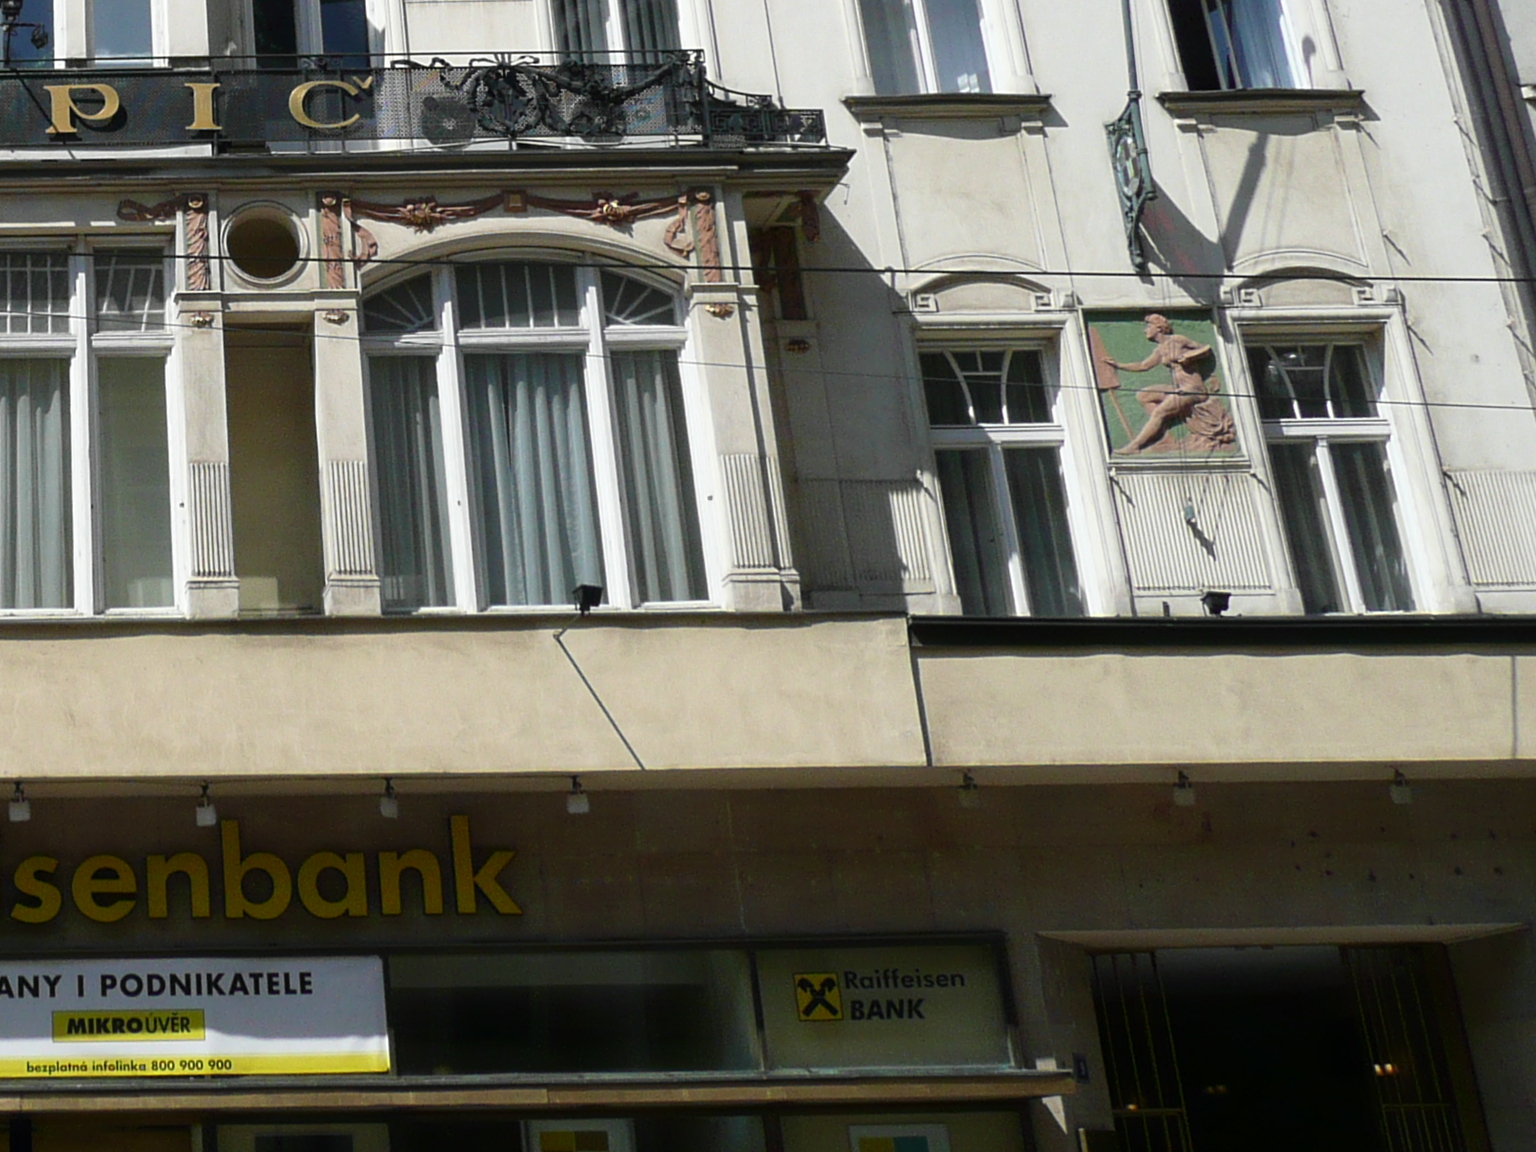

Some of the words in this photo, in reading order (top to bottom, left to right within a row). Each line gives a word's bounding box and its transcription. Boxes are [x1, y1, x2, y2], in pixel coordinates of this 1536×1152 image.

[76, 974, 86, 998] I
[99, 971, 314, 997] PODNIKATELE
[844, 968, 966, 990] Raiffeisen
[850, 999, 926, 1021] BANK
[66, 1011, 192, 1036] MIKROÚVĚR
[25, 1060, 89, 1075] bezplatná
[91, 1058, 147, 1073] infolinka
[150, 1060, 176, 1072] 800
[179, 1059, 205, 1071] 900
[208, 1059, 233, 1071] 900
